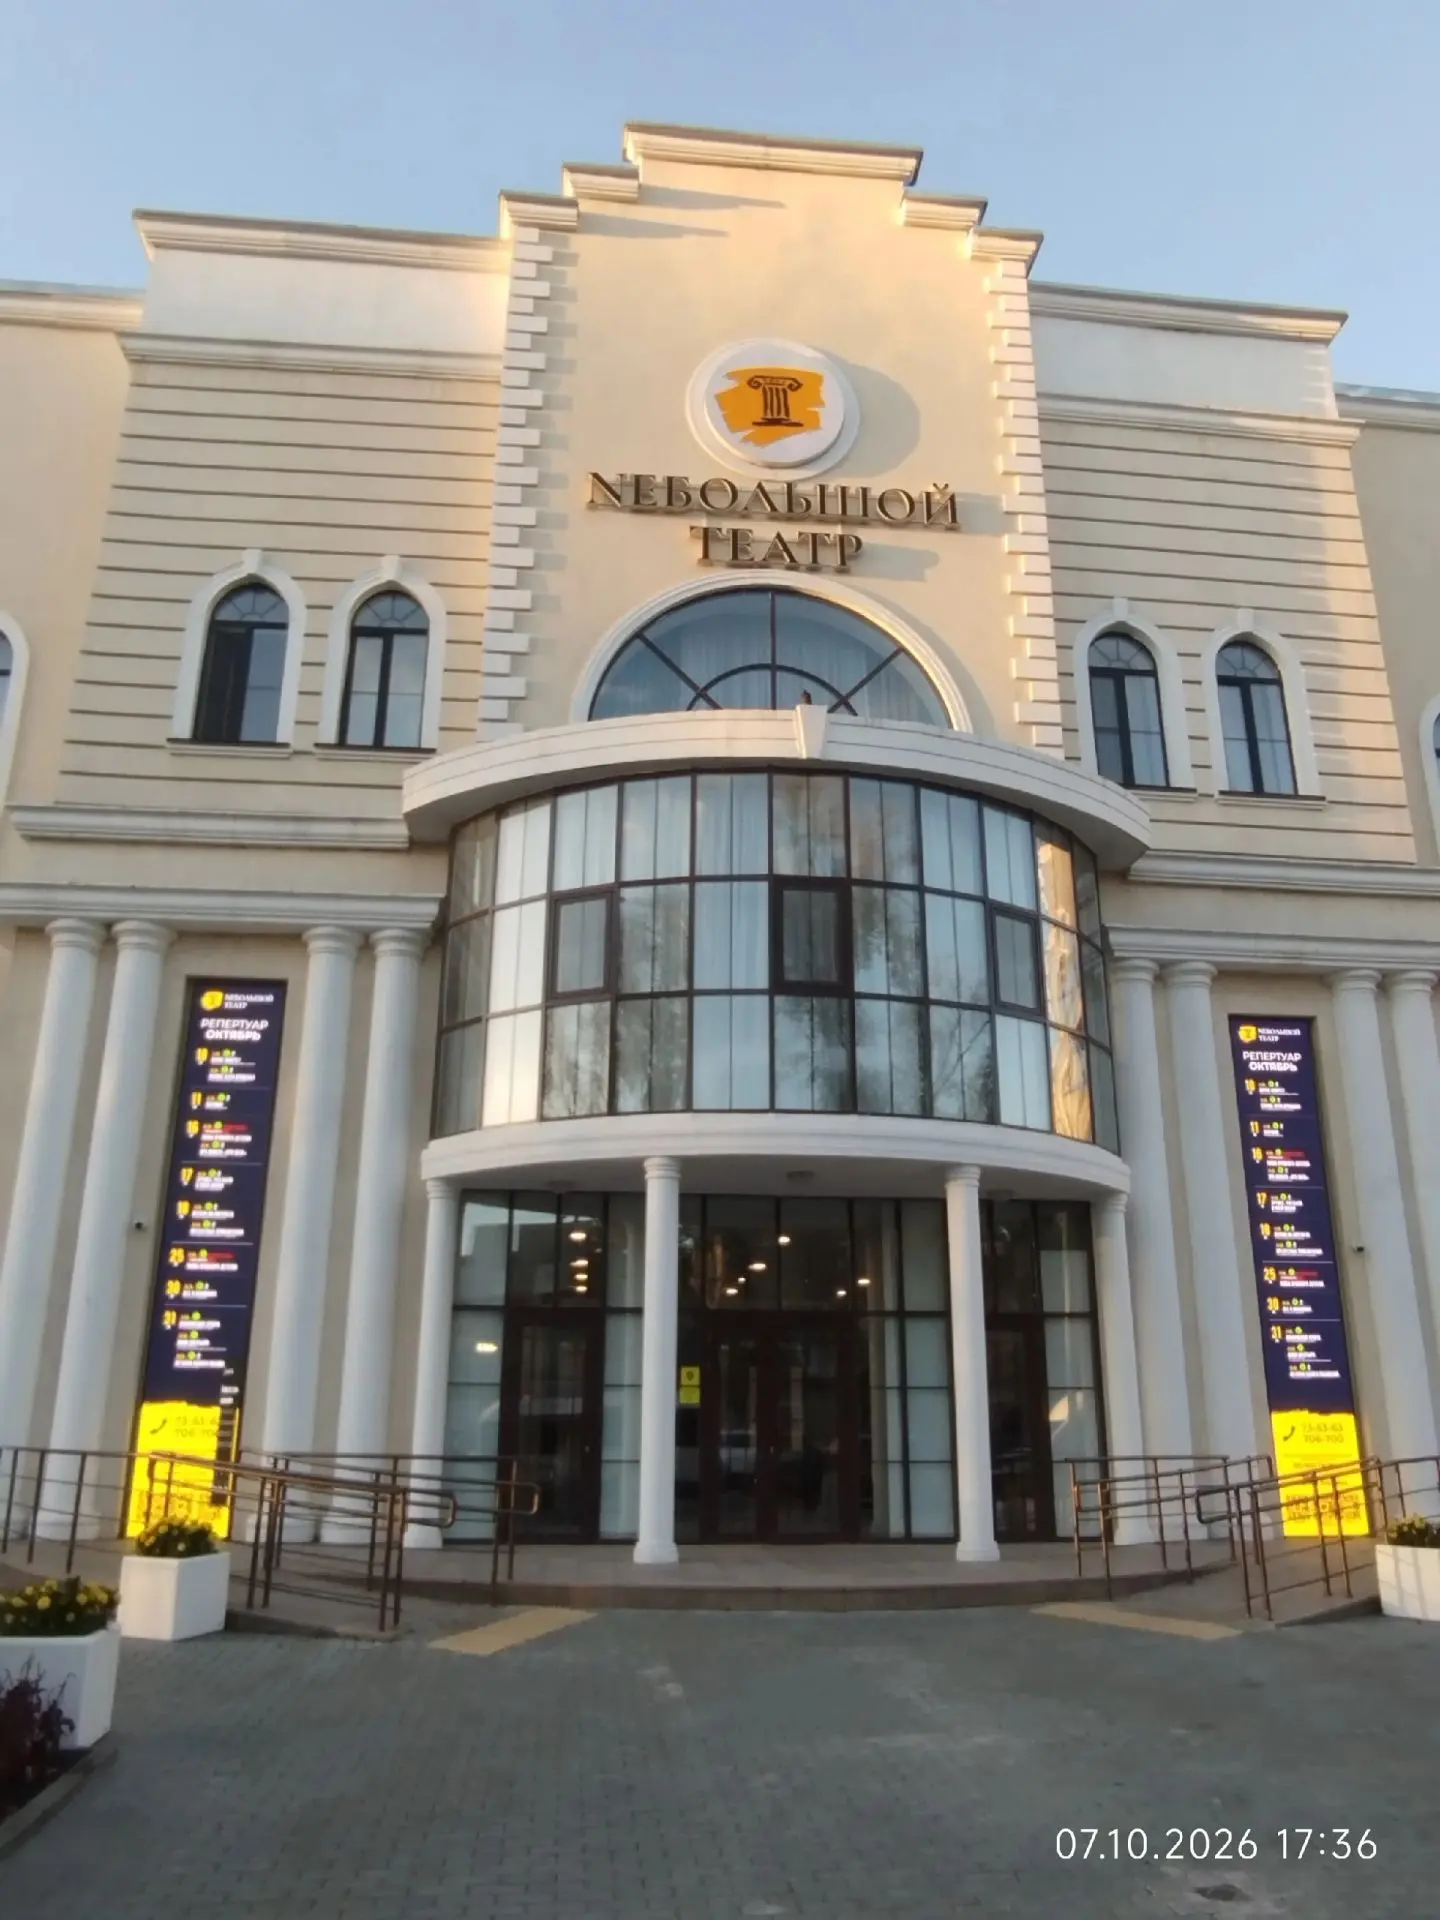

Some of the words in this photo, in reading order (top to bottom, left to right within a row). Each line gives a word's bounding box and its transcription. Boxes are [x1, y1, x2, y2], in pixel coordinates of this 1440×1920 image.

[690, 526, 863, 572] ТЕАТР
[200, 1018, 269, 1030] РЕПЕРТУАР
[1242, 1051, 1302, 1062] РЕПЕРТУАР
[1248, 1061, 1298, 1072] ОКТЯБРЬ
